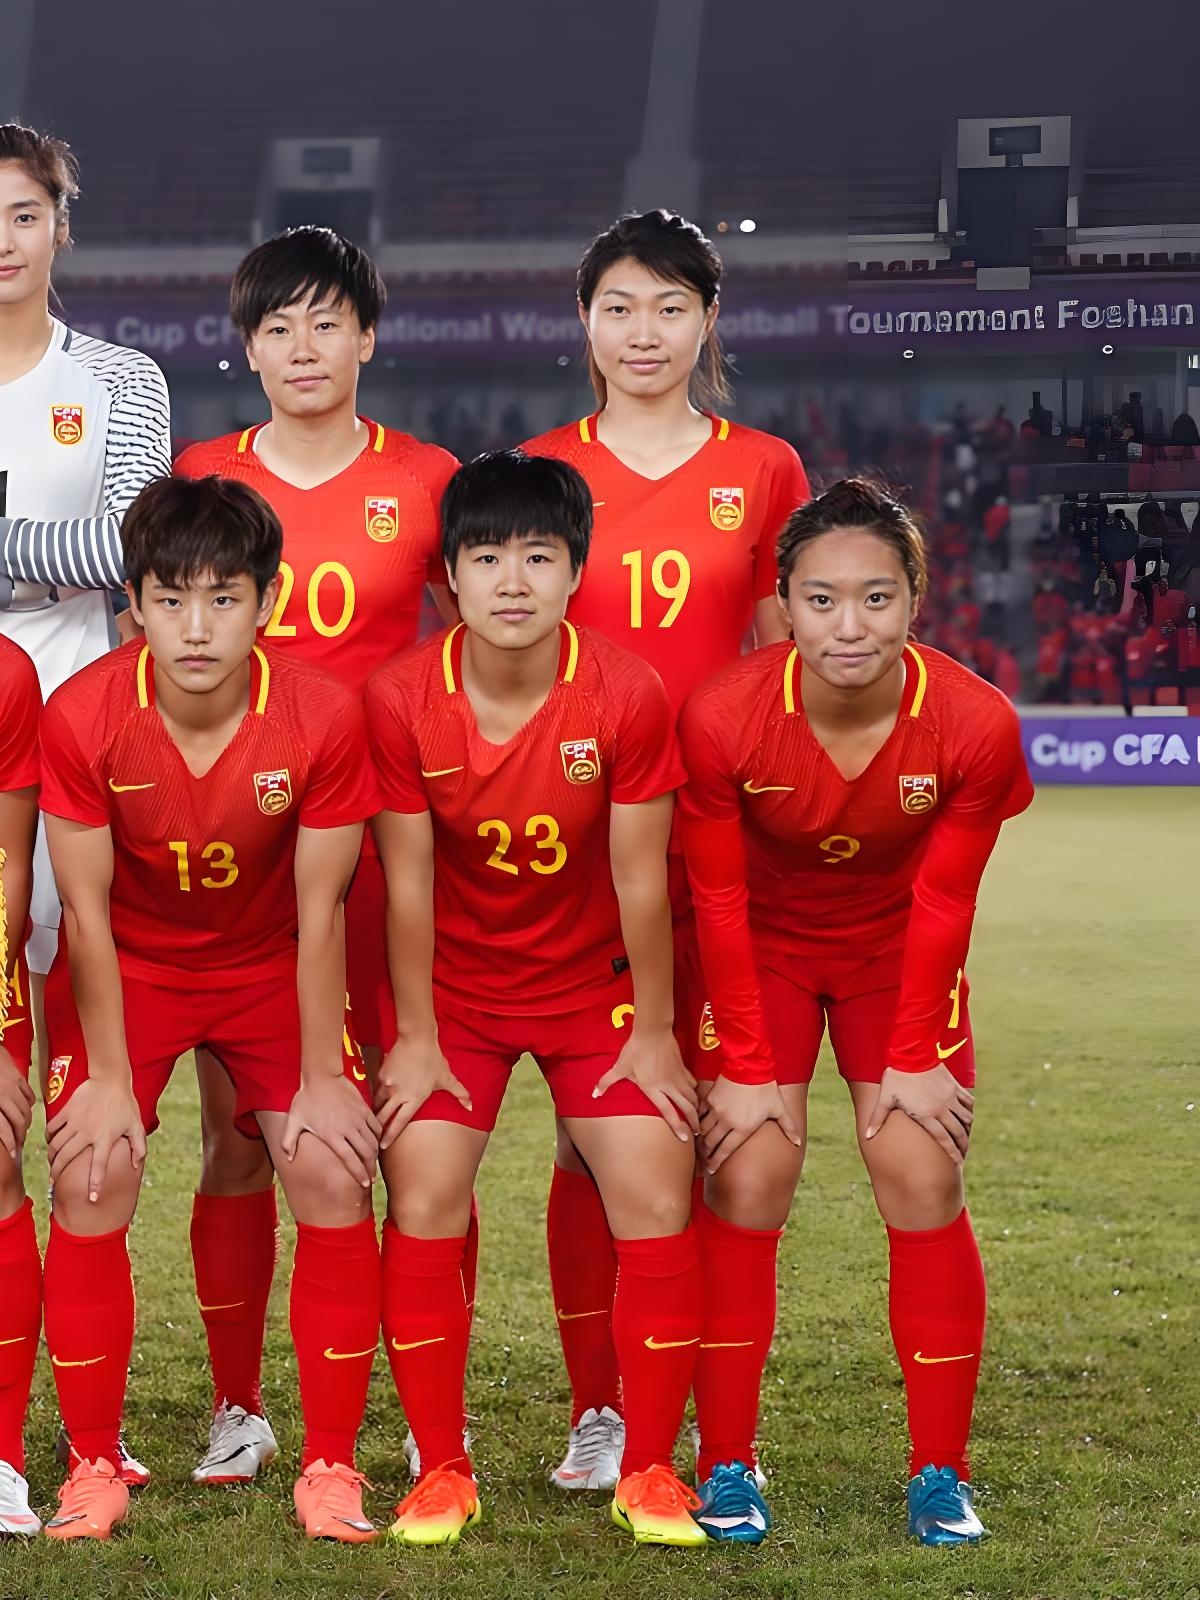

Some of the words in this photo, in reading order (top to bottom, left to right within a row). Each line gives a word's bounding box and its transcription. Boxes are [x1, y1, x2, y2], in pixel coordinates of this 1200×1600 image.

[264, 561, 356, 637] 20
[622, 550, 691, 628] 19
[1031, 733, 1106, 773] Cup
[1113, 733, 1191, 765] CFA
[168, 841, 239, 892] 13
[477, 815, 568, 876] 23
[819, 835, 860, 864] 9
